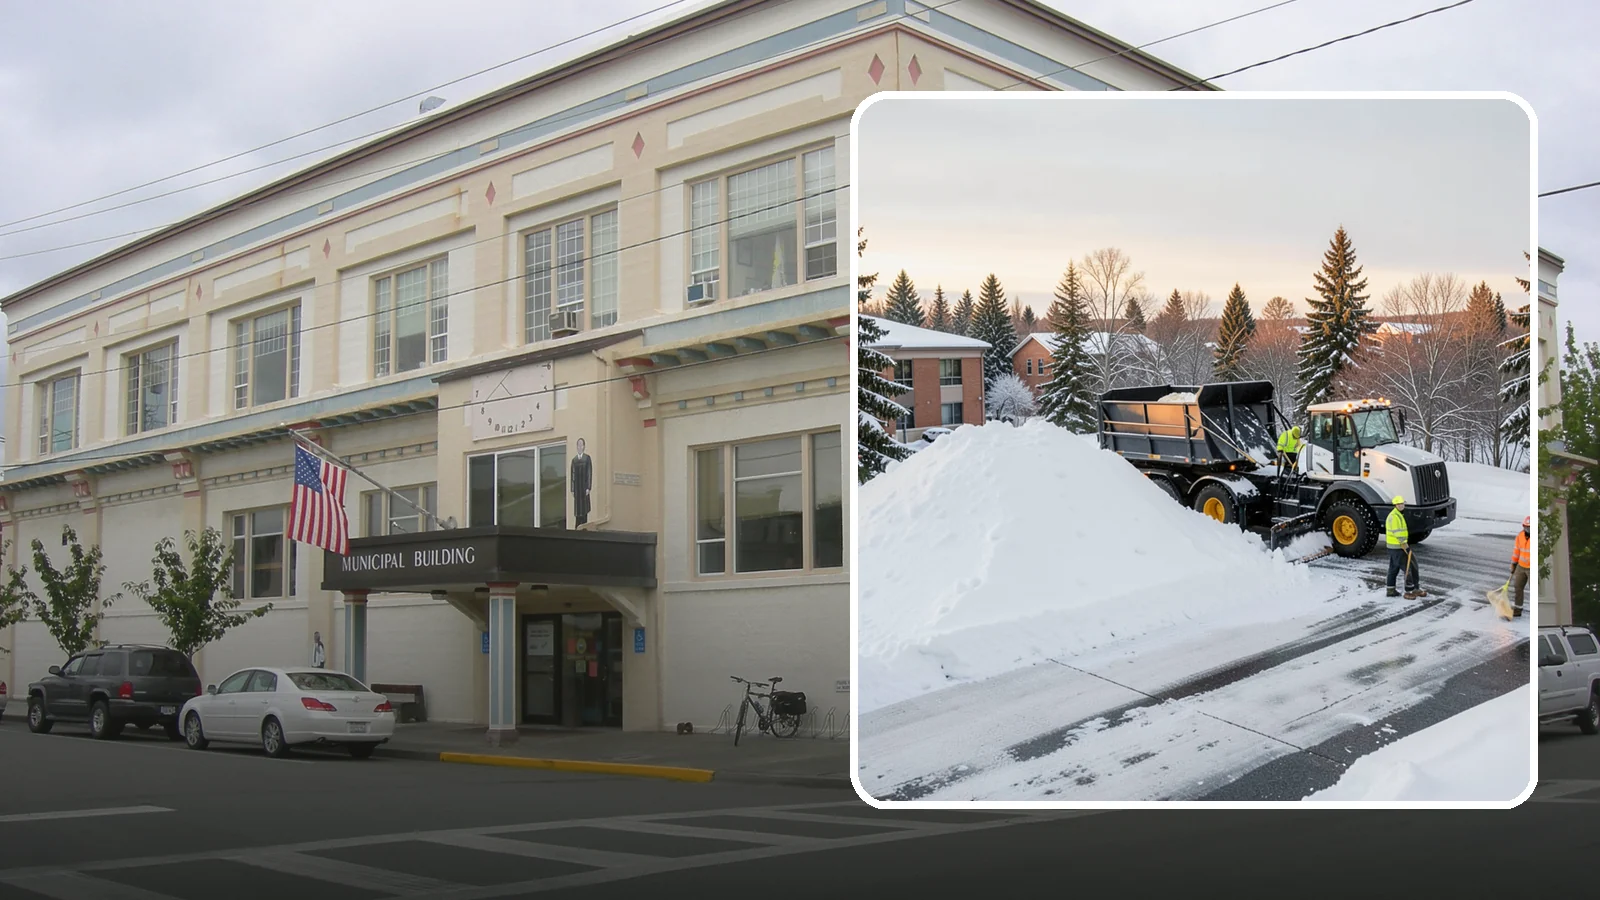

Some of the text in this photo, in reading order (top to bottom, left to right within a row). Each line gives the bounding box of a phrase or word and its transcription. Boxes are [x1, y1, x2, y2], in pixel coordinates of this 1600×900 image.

[547, 362, 551, 370] 6
[476, 390, 479, 398] 7
[536, 402, 540, 410] 4
[481, 407, 484, 415] 8
[488, 418, 492, 426] 9
[529, 414, 533, 422] 3
[521, 420, 525, 428] 2
[495, 424, 500, 432] 10
[508, 425, 513, 434] 12
[342, 546, 475, 571] MUNICIPAL BUILDING
